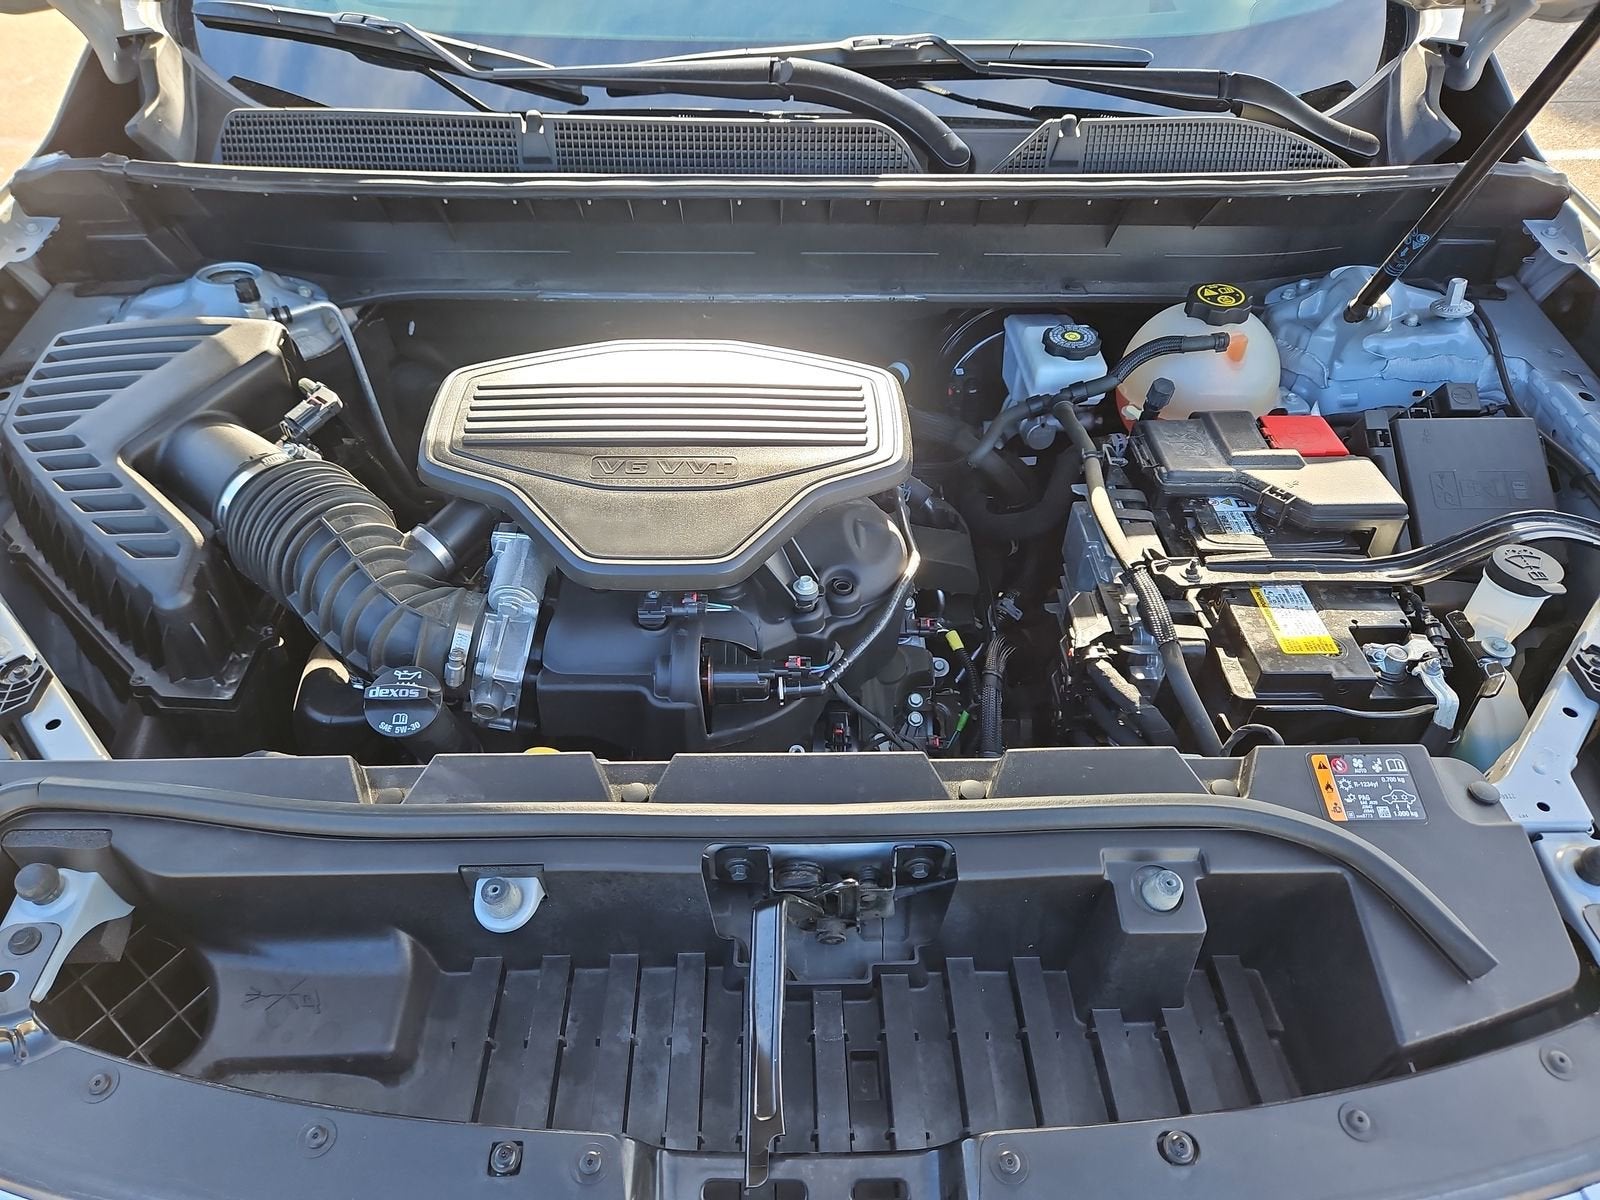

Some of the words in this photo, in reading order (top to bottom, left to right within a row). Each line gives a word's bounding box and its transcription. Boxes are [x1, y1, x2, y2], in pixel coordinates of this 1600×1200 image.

[597, 460, 649, 474] V6
[656, 460, 733, 474] VVT
[368, 686, 420, 698] dexos
[378, 721, 393, 733] SAE
[394, 721, 421, 734] 5W-30
